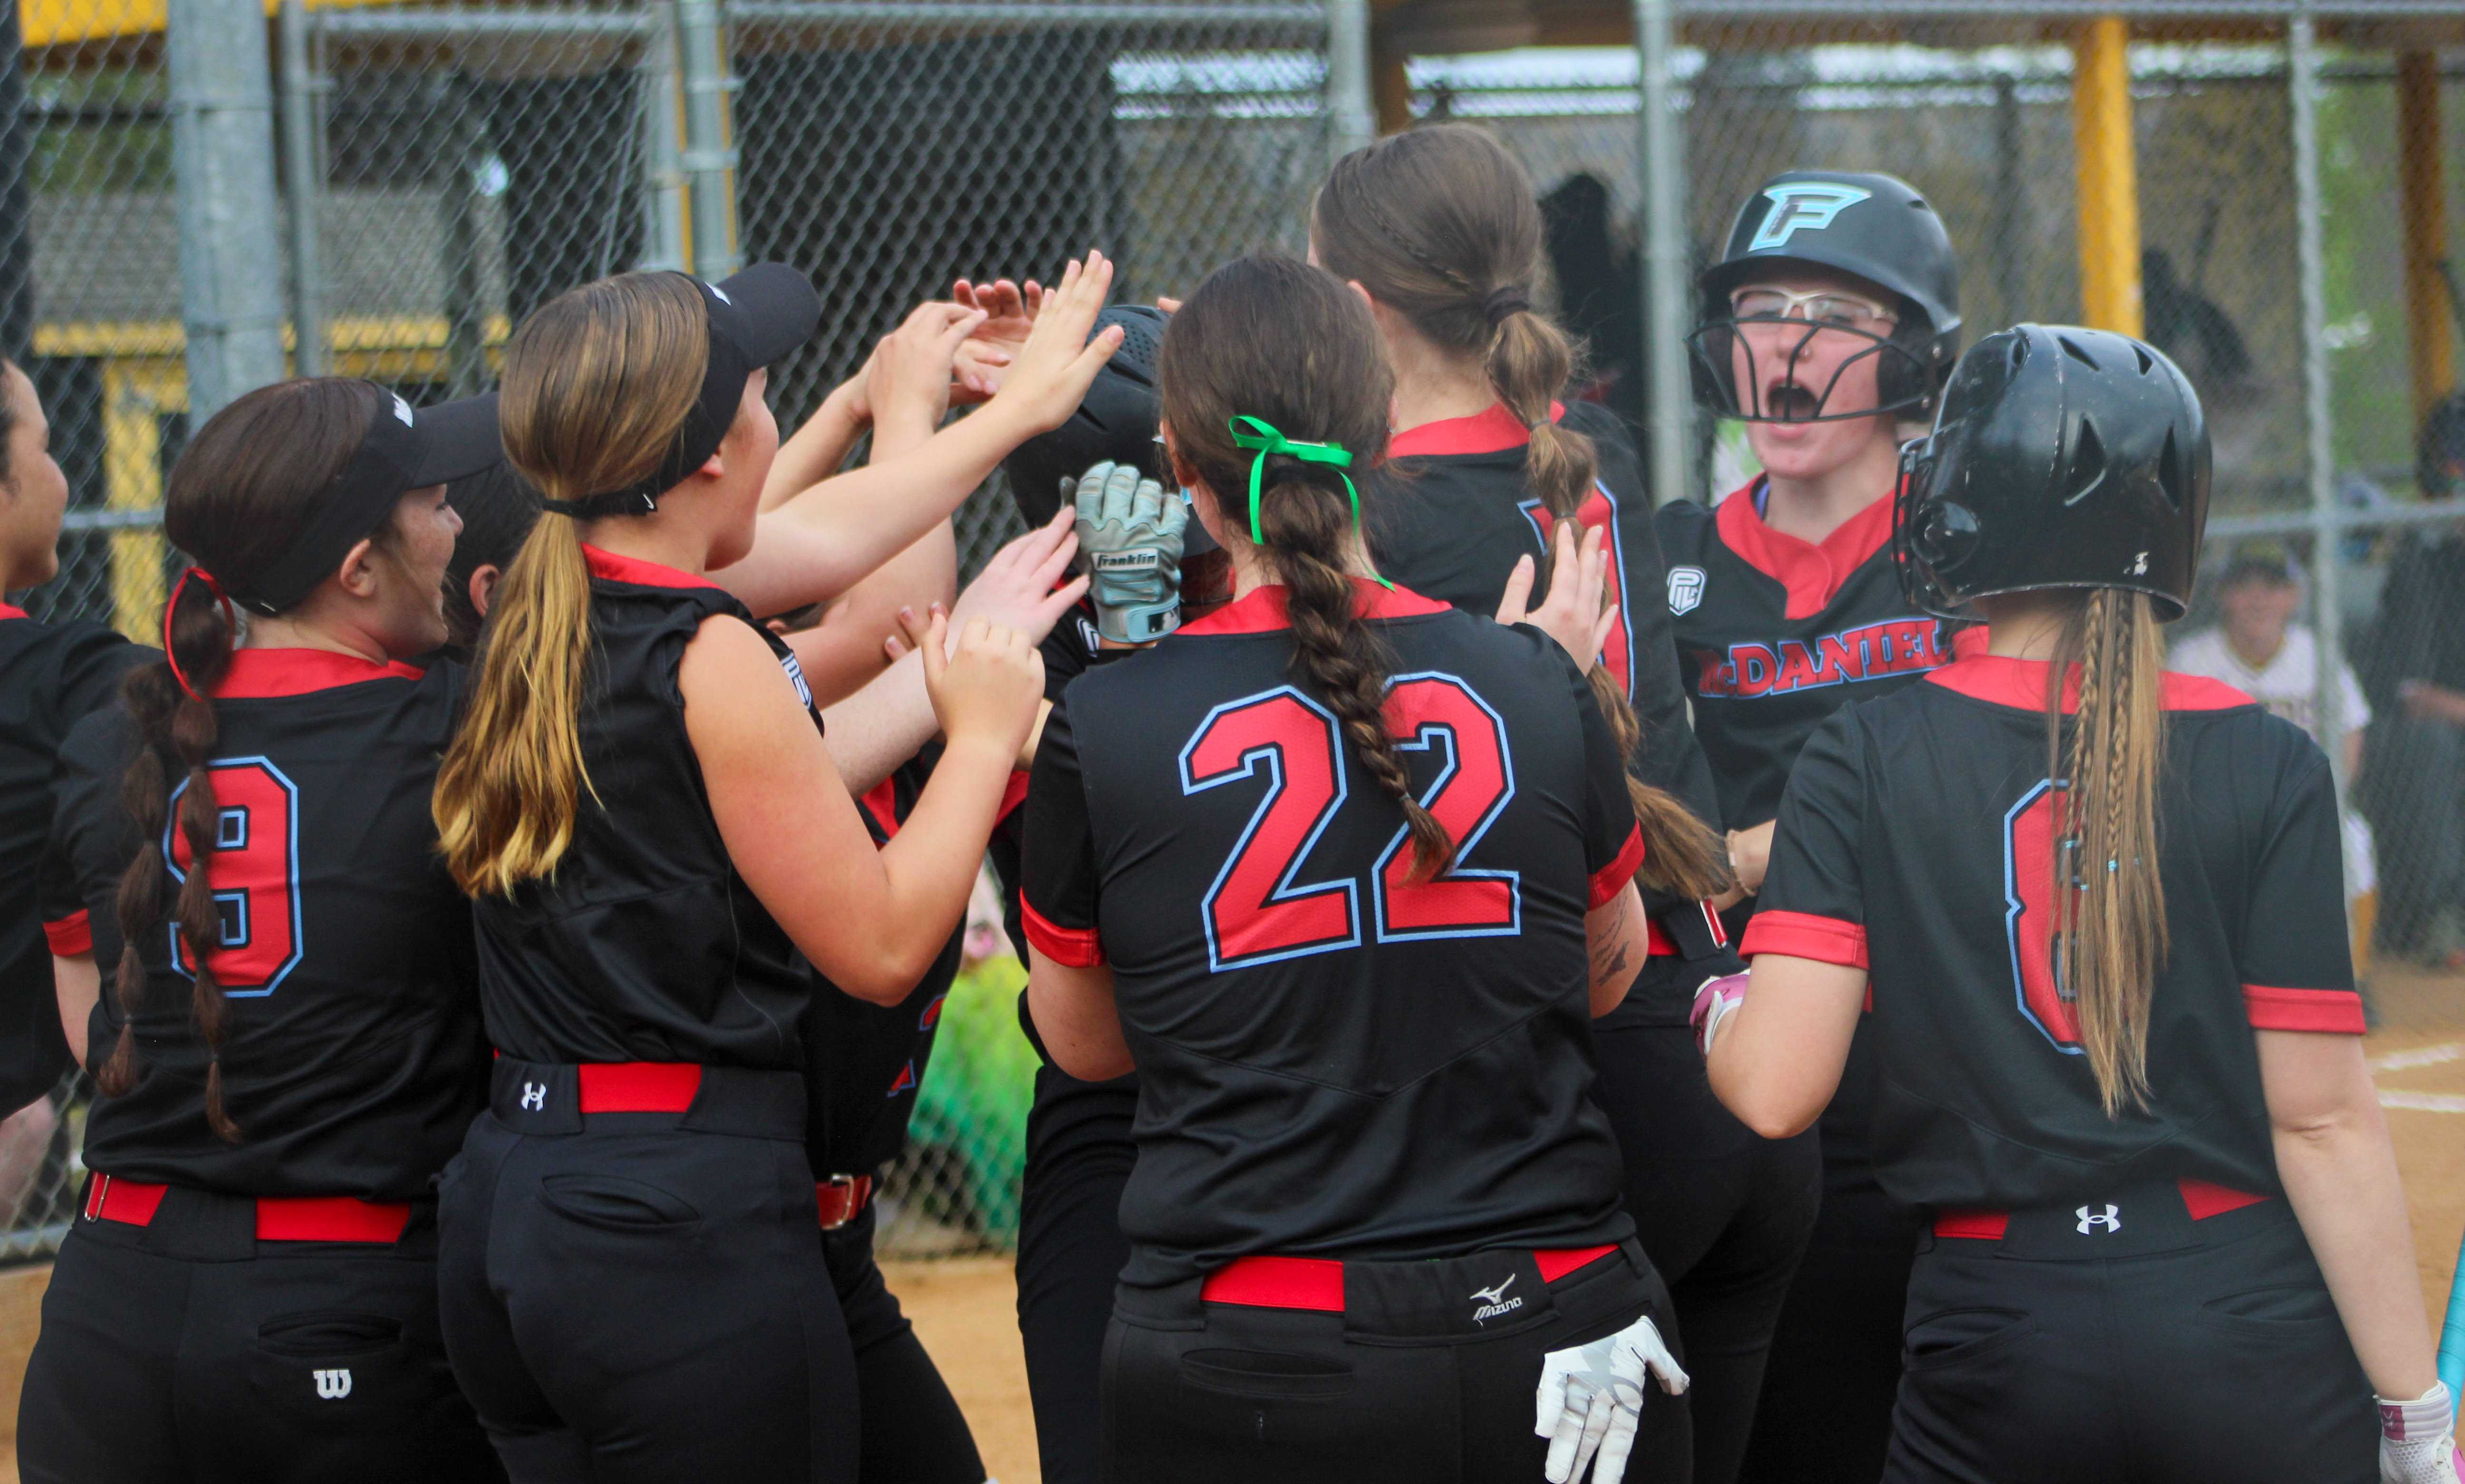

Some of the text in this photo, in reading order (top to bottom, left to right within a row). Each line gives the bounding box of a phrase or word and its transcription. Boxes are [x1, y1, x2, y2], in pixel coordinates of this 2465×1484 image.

[1748, 185, 1872, 252] F
[1097, 554, 1156, 568] franklin
[163, 755, 303, 998] 9
[1178, 671, 1521, 973] 22
